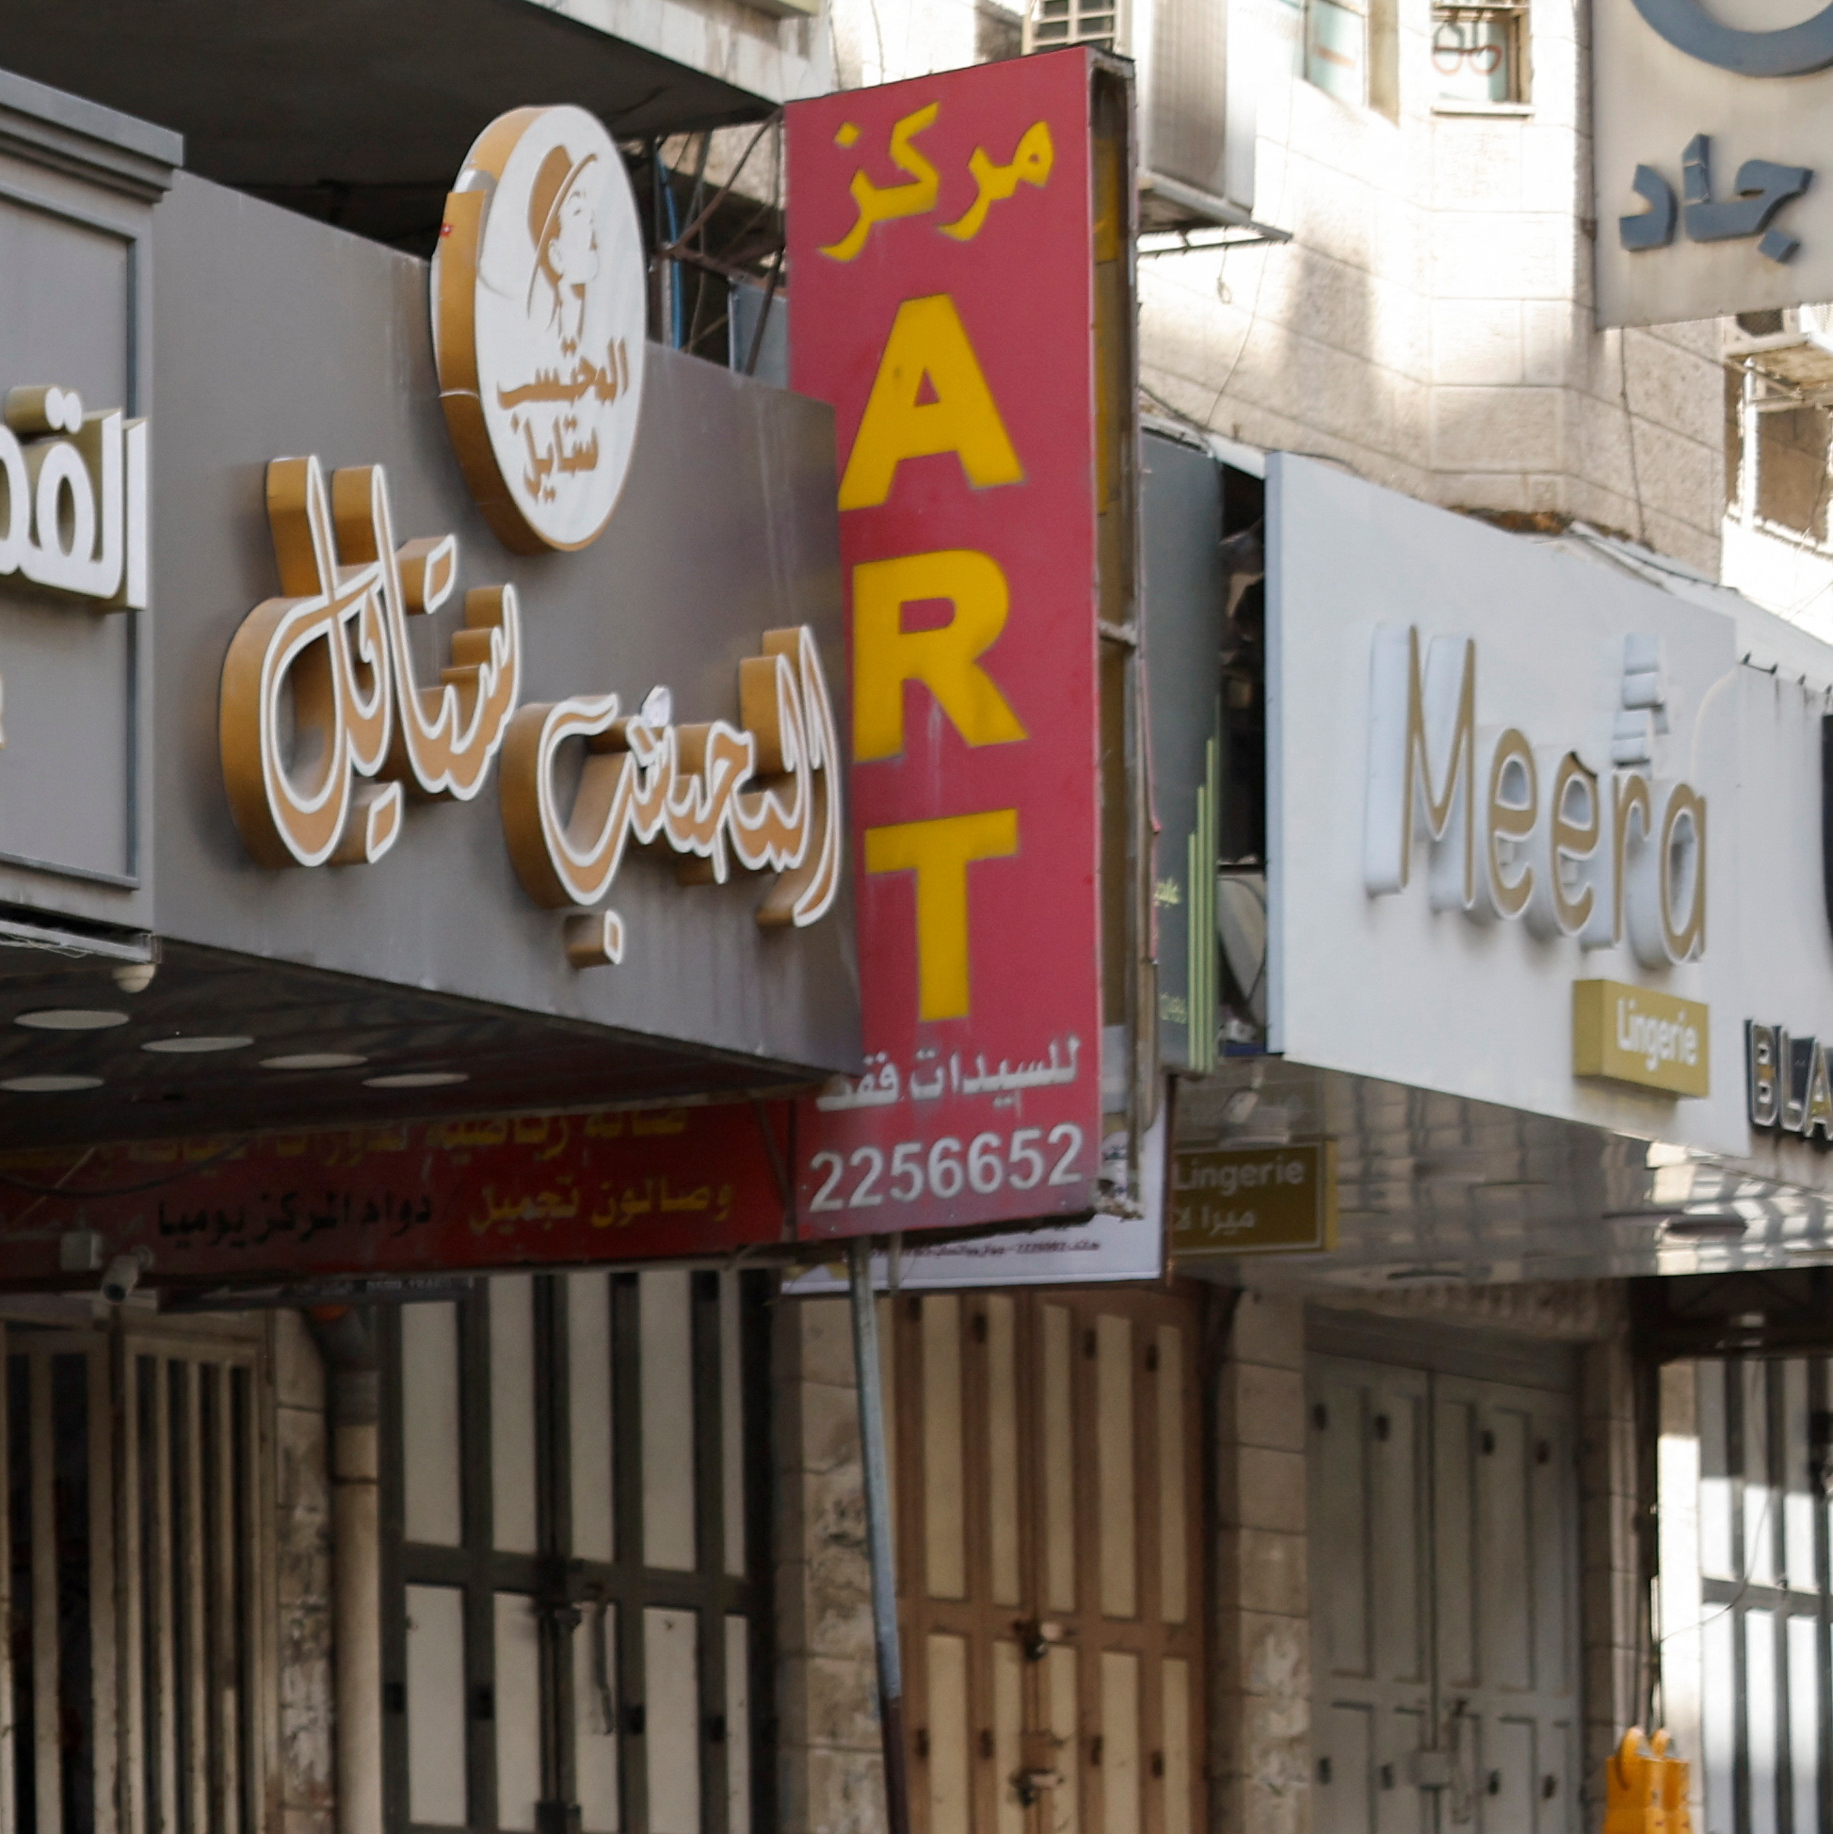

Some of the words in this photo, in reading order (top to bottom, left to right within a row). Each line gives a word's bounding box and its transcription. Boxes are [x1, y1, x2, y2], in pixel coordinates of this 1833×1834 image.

[818, 101, 1054, 262] مركز
[837, 293, 1029, 1023] ART
[1401, 624, 1708, 967] Meera
[907, 1029, 1082, 1109] للسيدات
[1616, 997, 1699, 1072] Lingerie
[808, 1121, 1084, 1214] 2256652
[1174, 1154, 1306, 1197] Lingerie
